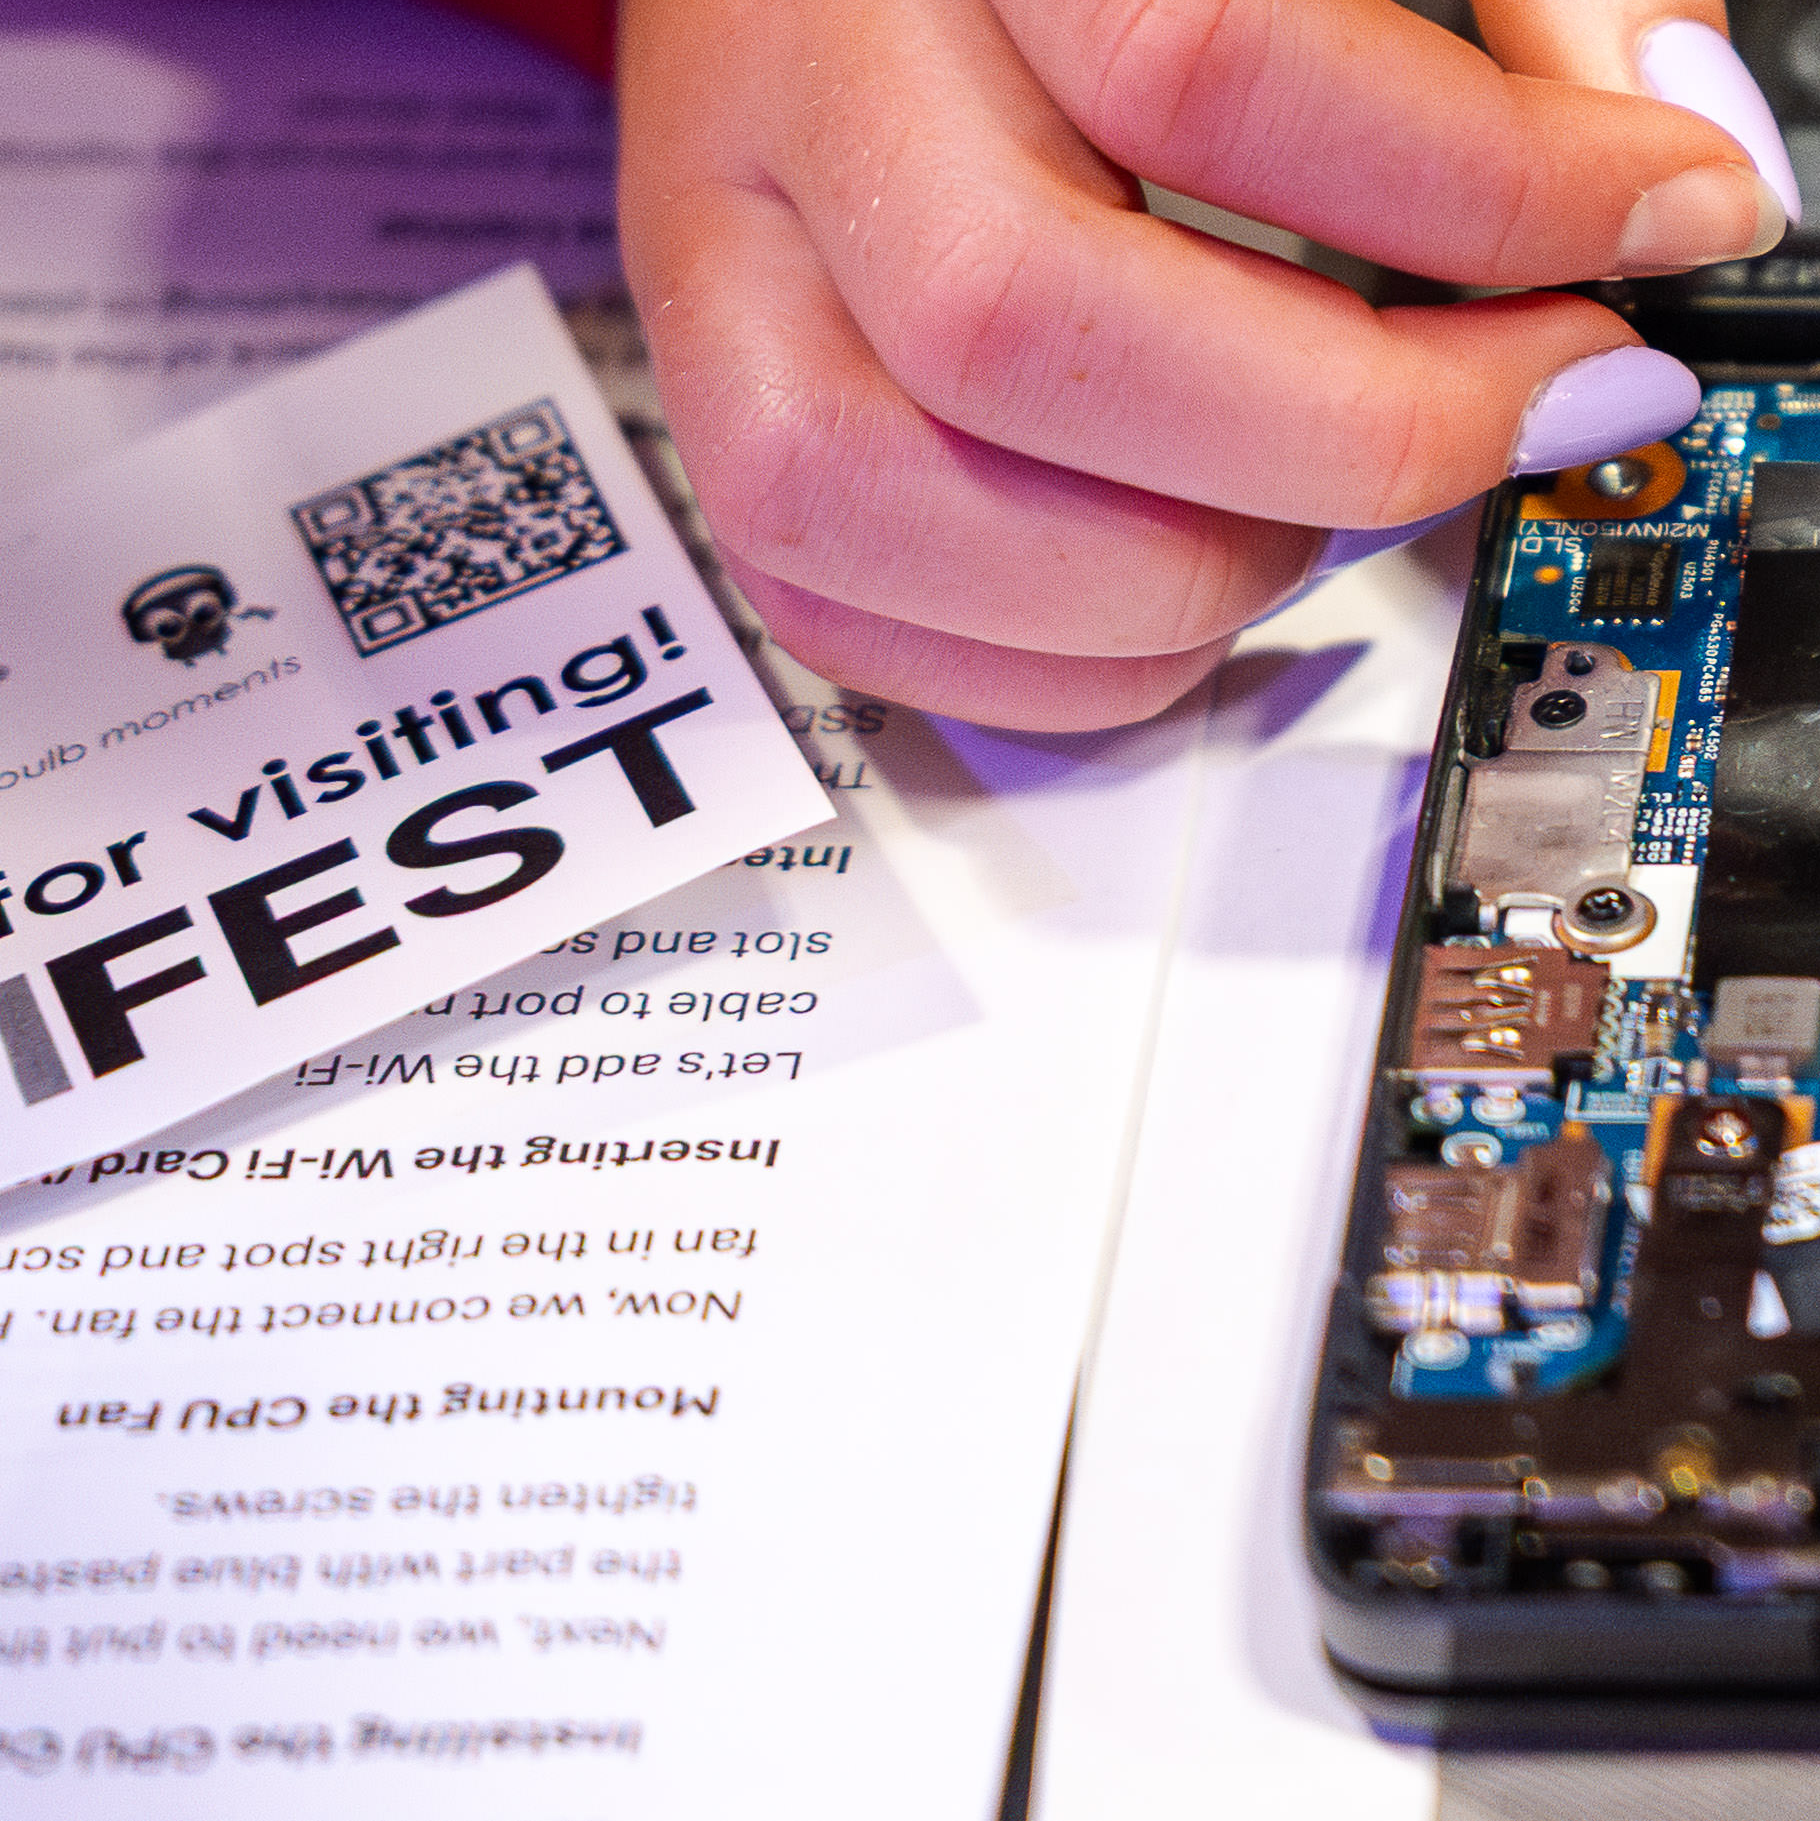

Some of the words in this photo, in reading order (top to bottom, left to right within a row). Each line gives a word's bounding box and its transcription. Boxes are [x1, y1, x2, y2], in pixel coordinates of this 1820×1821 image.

[100, 656, 301, 748] moments
[190, 604, 689, 842] visiting!
[613, 930, 715, 957] and
[737, 930, 834, 955] slot
[472, 985, 586, 1018] port
[602, 989, 650, 1018] to
[670, 989, 819, 1018] cable
[294, 1050, 434, 1086] Wi-Fi
[455, 1052, 541, 1083] the
[559, 1052, 658, 1085] add
[678, 1050, 803, 1083] Let's
[90, 1147, 228, 1182] Card
[244, 1146, 394, 1180] Wi-Fi
[414, 1143, 506, 1172] the
[525, 1135, 781, 1169] Inserting
[102, 1239, 205, 1275] and
[224, 1235, 346, 1272] spot
[359, 1228, 483, 1271] right
[502, 1230, 588, 1263] the
[609, 1227, 652, 1261] in
[673, 1225, 759, 1261] fan
[36, 1303, 137, 1339] fan.
[155, 1300, 244, 1333] the
[256, 1291, 491, 1333] connect
[508, 1292, 586, 1319] we
[608, 1286, 744, 1324] Now,
[59, 1396, 161, 1435] Fan
[181, 1394, 307, 1433] CPU
[328, 1388, 422, 1421] the
[443, 1382, 720, 1421] Mounting
[156, 1485, 373, 1525] screws.
[391, 1478, 480, 1518] the
[500, 1474, 698, 1516] tighten
[315, 1544, 442, 1583] with
[455, 1542, 577, 1586] part
[592, 1542, 684, 1585] the
